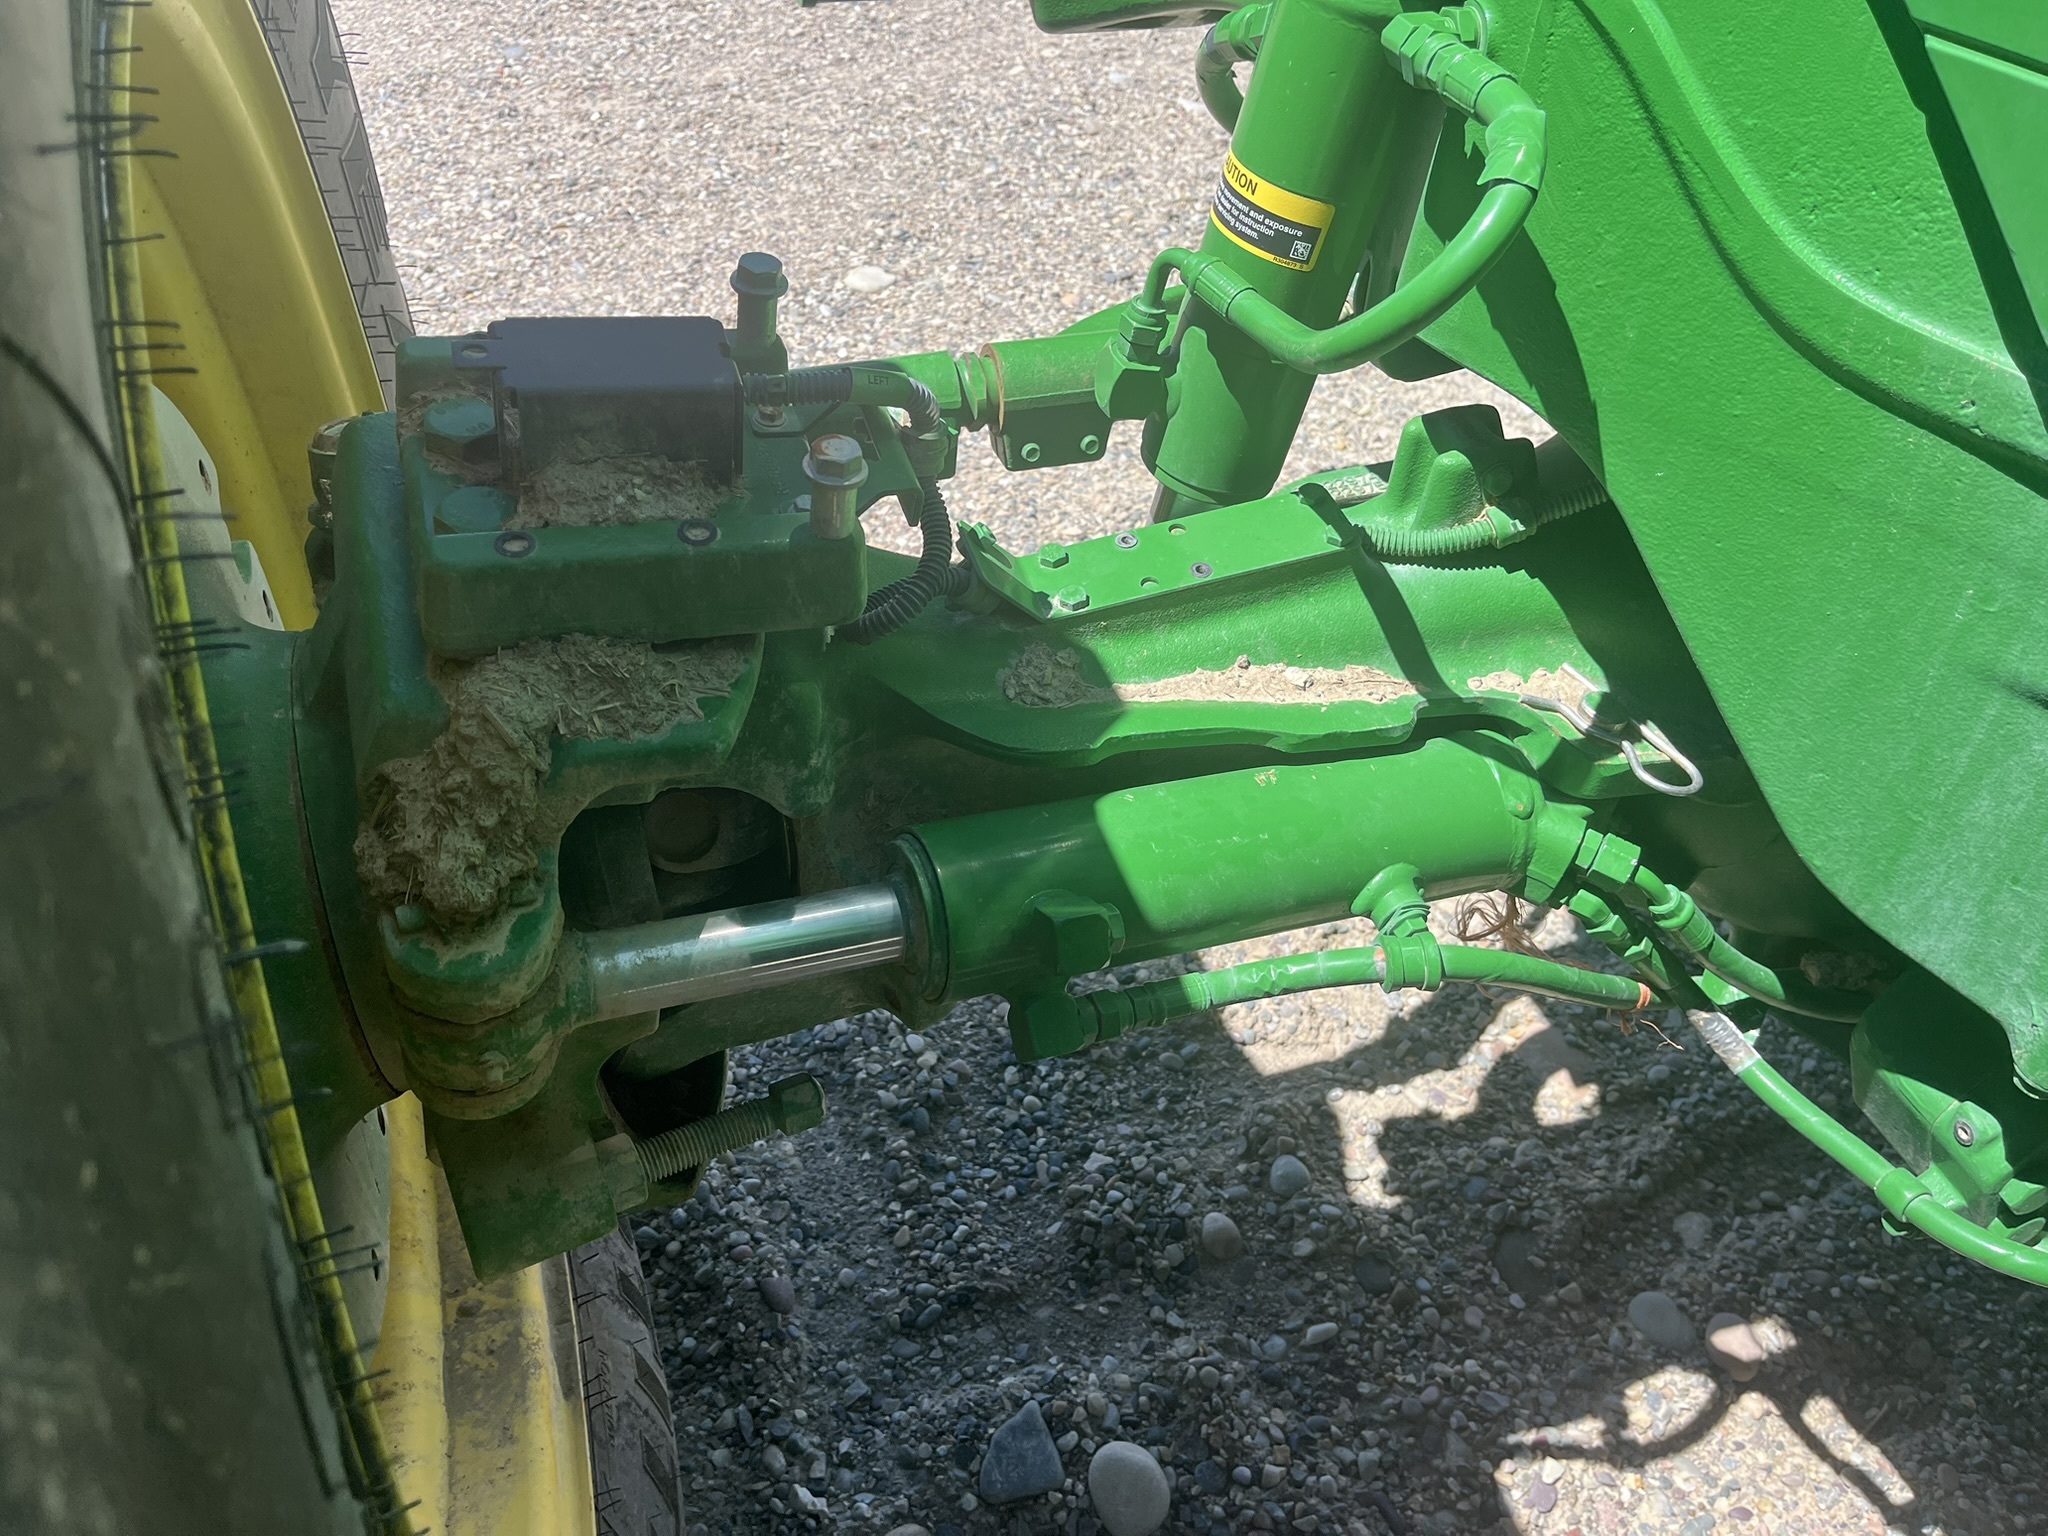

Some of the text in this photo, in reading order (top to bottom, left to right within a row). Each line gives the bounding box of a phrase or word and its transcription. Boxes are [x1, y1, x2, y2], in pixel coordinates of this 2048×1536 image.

[1231, 205, 1240, 217] for
[1238, 211, 1275, 237] instruction
[1234, 221, 1259, 240] system.
[1250, 210, 1264, 221] and
[1264, 217, 1303, 237] exposure
[867, 374, 889, 386] LEFT
